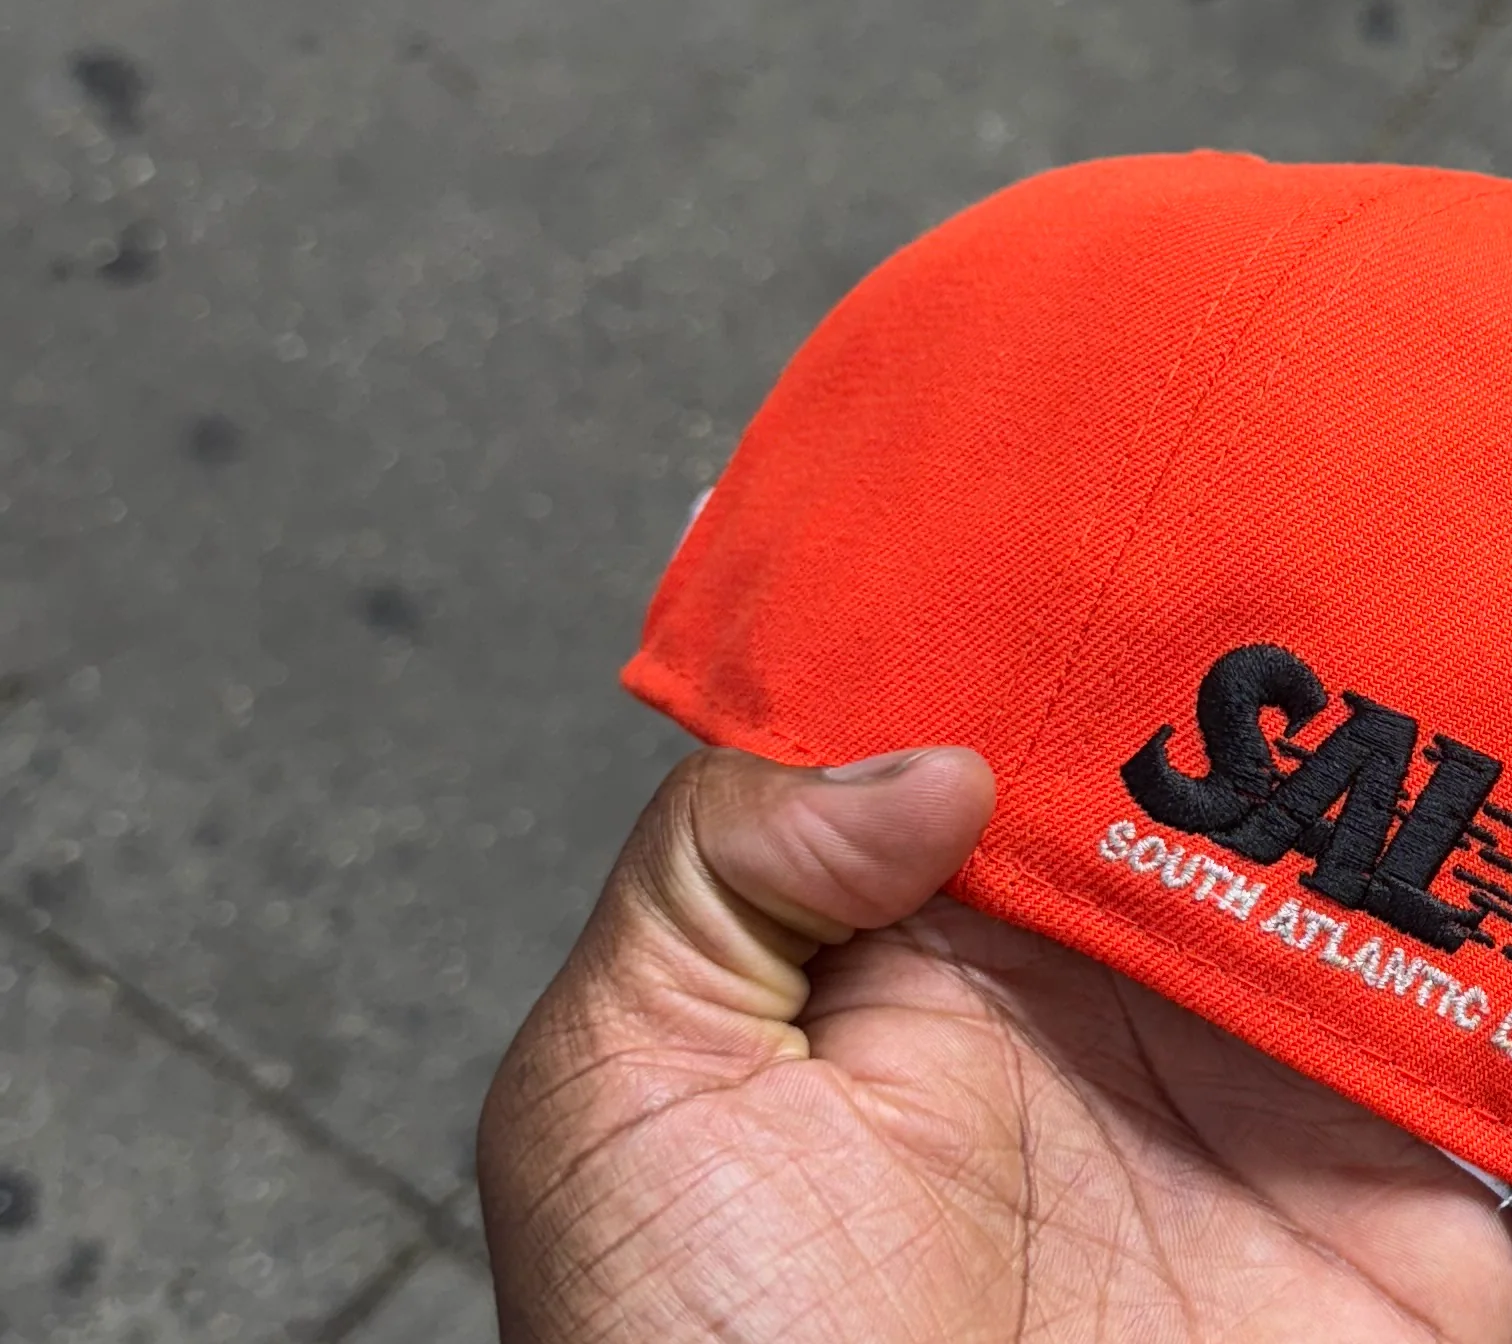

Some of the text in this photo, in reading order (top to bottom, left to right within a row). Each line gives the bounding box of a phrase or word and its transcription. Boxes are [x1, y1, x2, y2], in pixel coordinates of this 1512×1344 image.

[1100, 820, 1266, 921] SOUTH
[1260, 897, 1492, 1031] ATLANTIC
[1120, 642, 1503, 953] SAL
